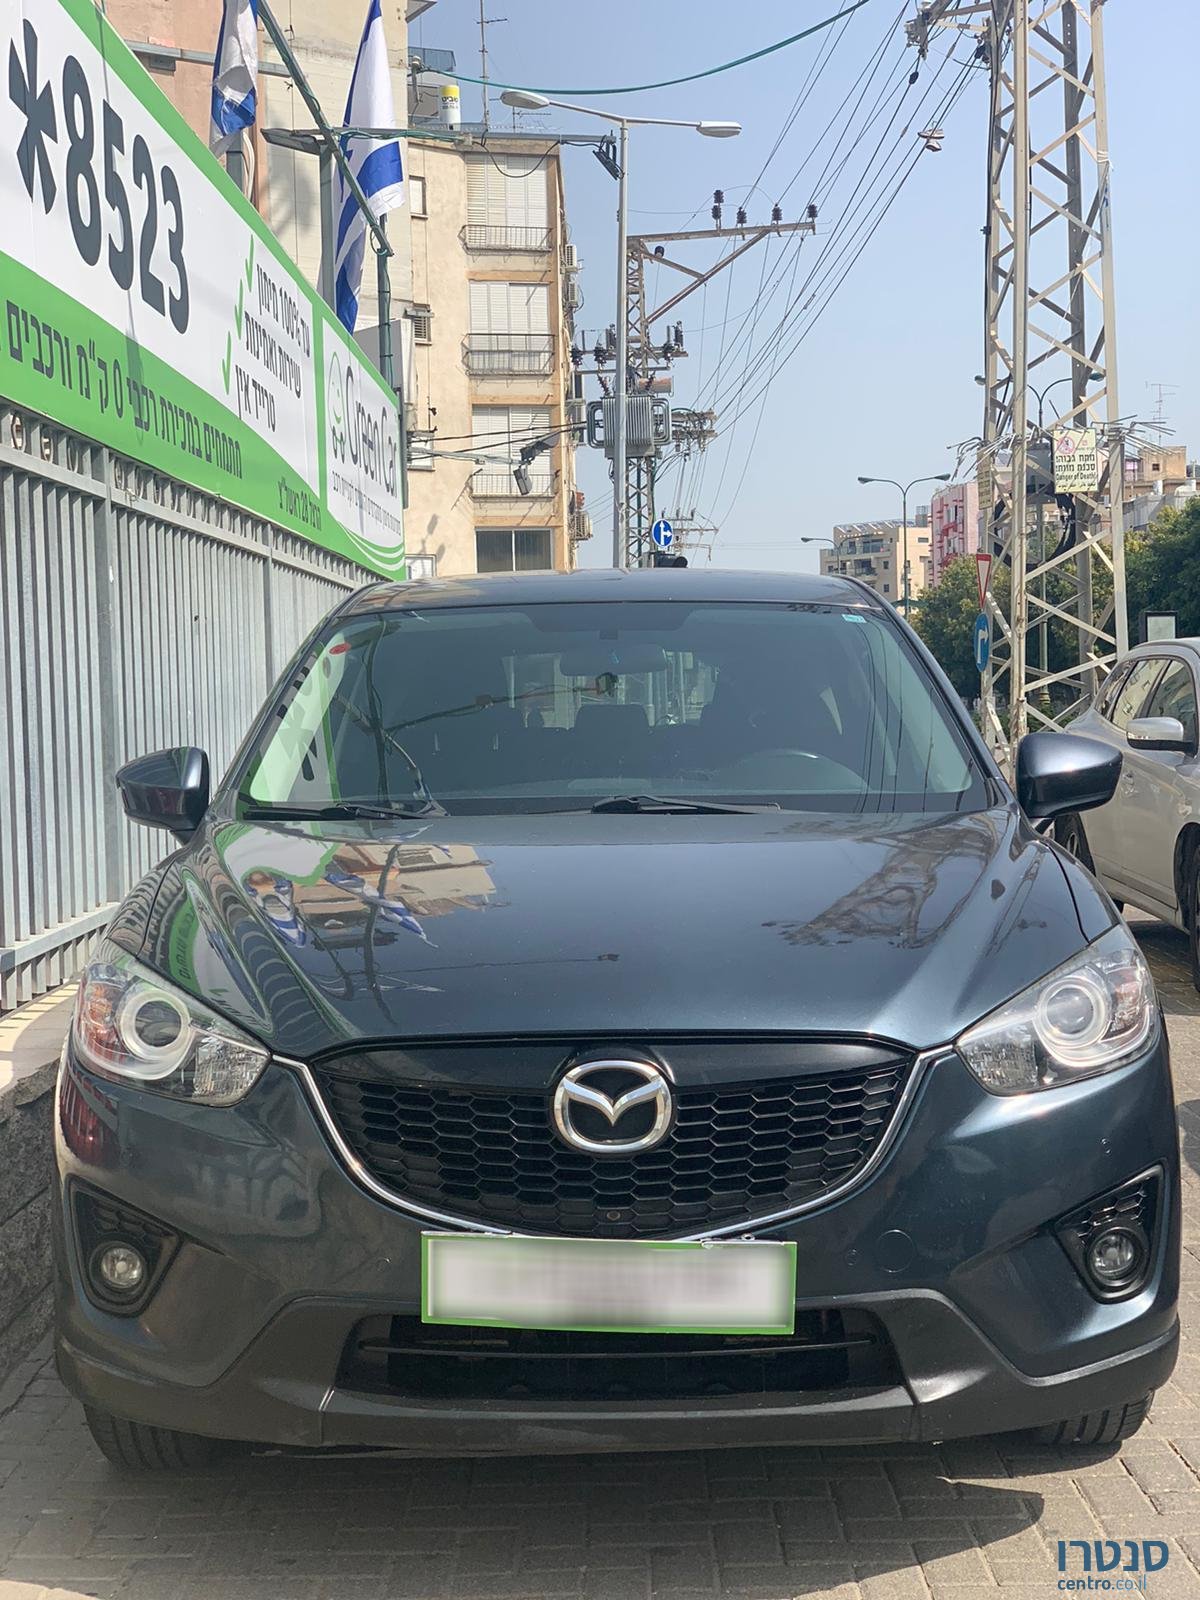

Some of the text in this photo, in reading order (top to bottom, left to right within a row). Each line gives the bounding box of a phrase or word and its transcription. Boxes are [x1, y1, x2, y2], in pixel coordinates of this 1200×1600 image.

[244, 310, 302, 399] שירות ואמינות
[256, 263, 311, 358] עד 100% מימון
[6, 299, 243, 479] מתמחים במכירת רכבי 0 ק"מ ורכבים
[235, 364, 277, 433] טרייד אין
[345, 364, 382, 486] Green
[380, 405, 398, 499] Car
